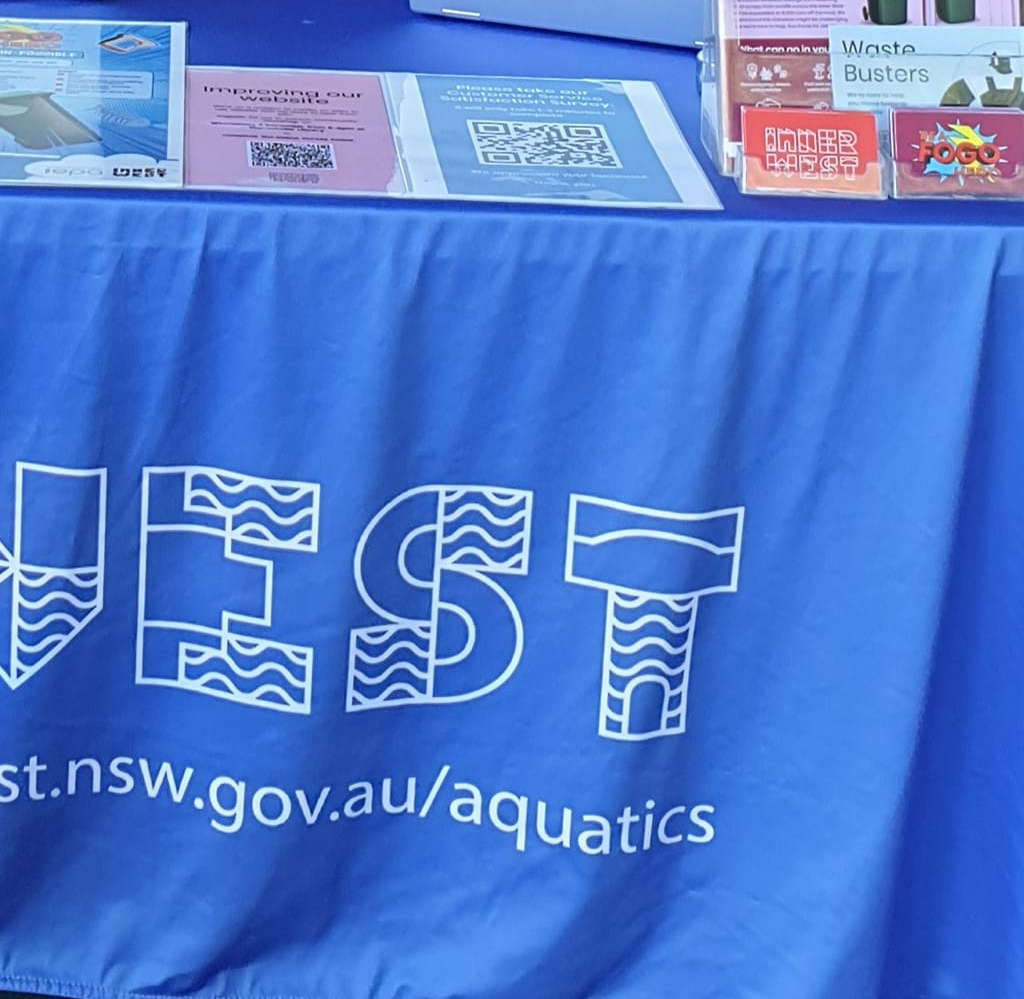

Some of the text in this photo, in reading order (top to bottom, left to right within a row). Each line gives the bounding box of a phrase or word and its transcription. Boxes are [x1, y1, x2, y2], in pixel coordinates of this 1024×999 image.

[842, 40, 916, 58] Waste
[844, 64, 930, 83] Busters
[203, 86, 320, 98] Improving
[446, 90, 534, 98] Customer
[455, 84, 514, 92] Please
[239, 95, 330, 104] website
[440, 94, 546, 105] Satisfaction
[765, 127, 857, 154] INNER
[918, 140, 1001, 165] FOGO
[766, 155, 859, 180] WEST
